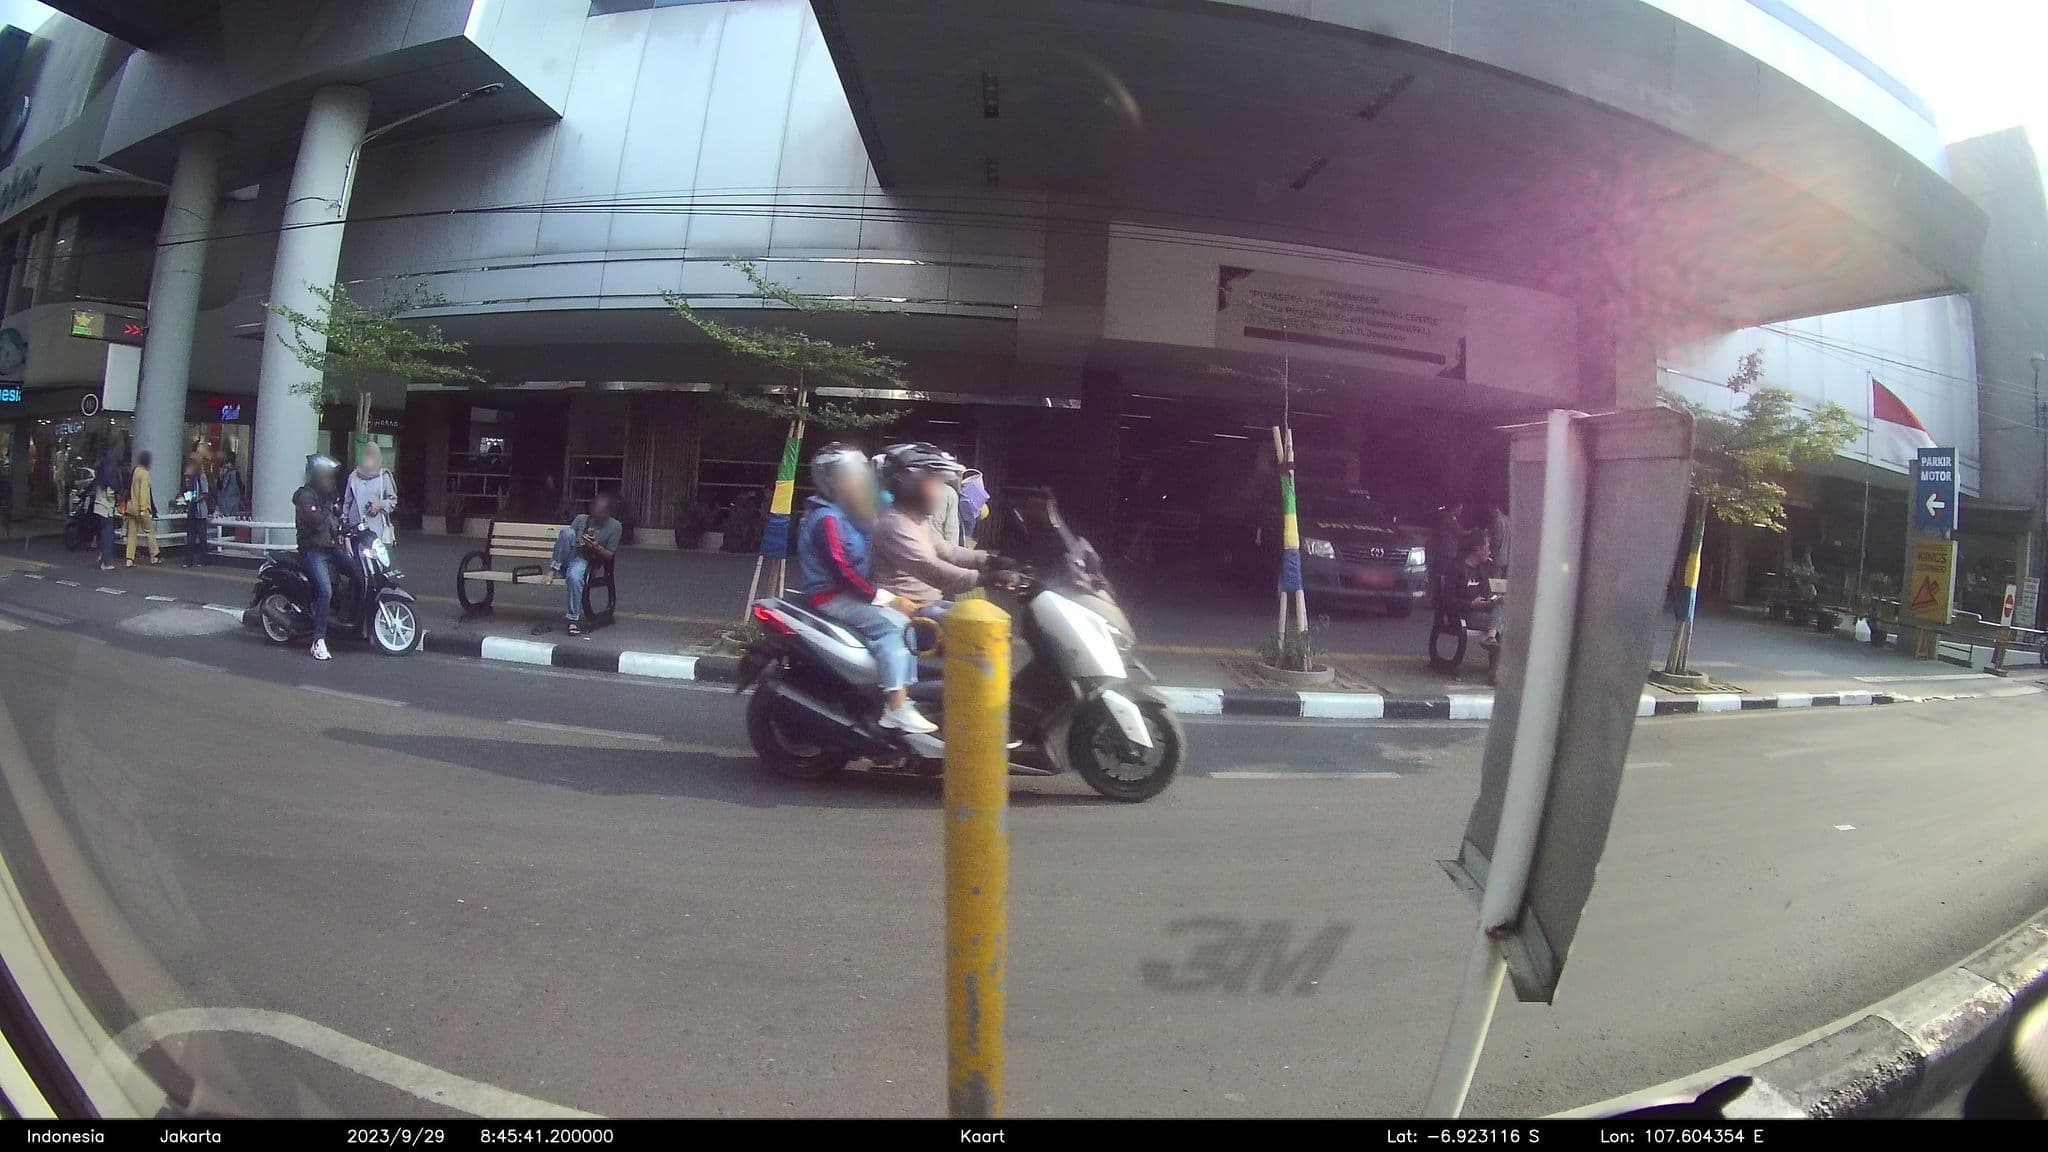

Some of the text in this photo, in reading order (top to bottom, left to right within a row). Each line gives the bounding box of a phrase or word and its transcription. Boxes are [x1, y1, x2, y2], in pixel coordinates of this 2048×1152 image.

[1921, 456, 1952, 467] PARKIR
[1920, 470, 1952, 482] MOTOR
[1139, 914, 1353, 996] 3M
